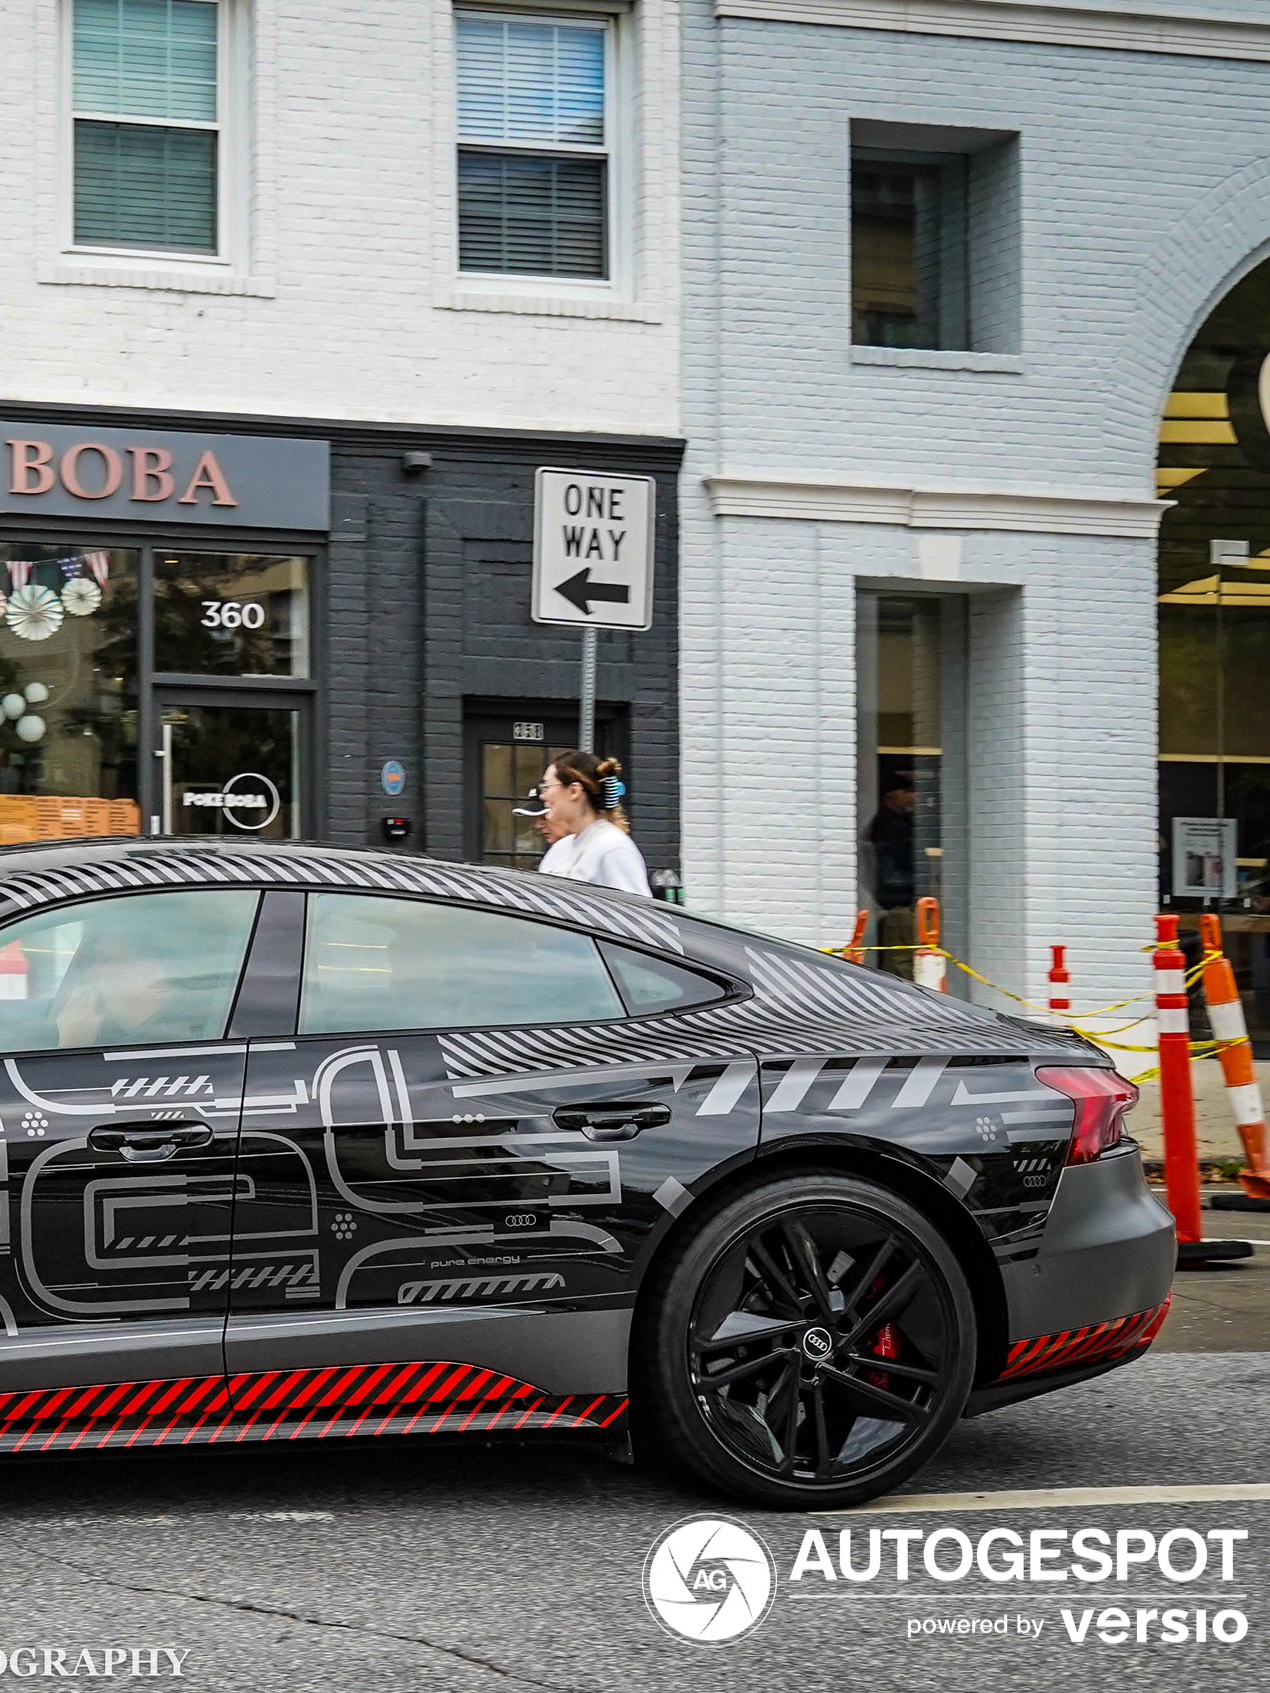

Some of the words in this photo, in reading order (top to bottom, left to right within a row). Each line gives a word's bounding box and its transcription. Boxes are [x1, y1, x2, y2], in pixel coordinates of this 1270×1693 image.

[6, 438, 238, 507] BOBA
[565, 484, 625, 521] ONE
[563, 525, 627, 562] WAY
[200, 601, 265, 630] 360
[183, 792, 224, 806] POKE
[224, 793, 268, 808] BOBA
[430, 1260, 465, 1269] pure
[468, 1256, 520, 1265] energy
